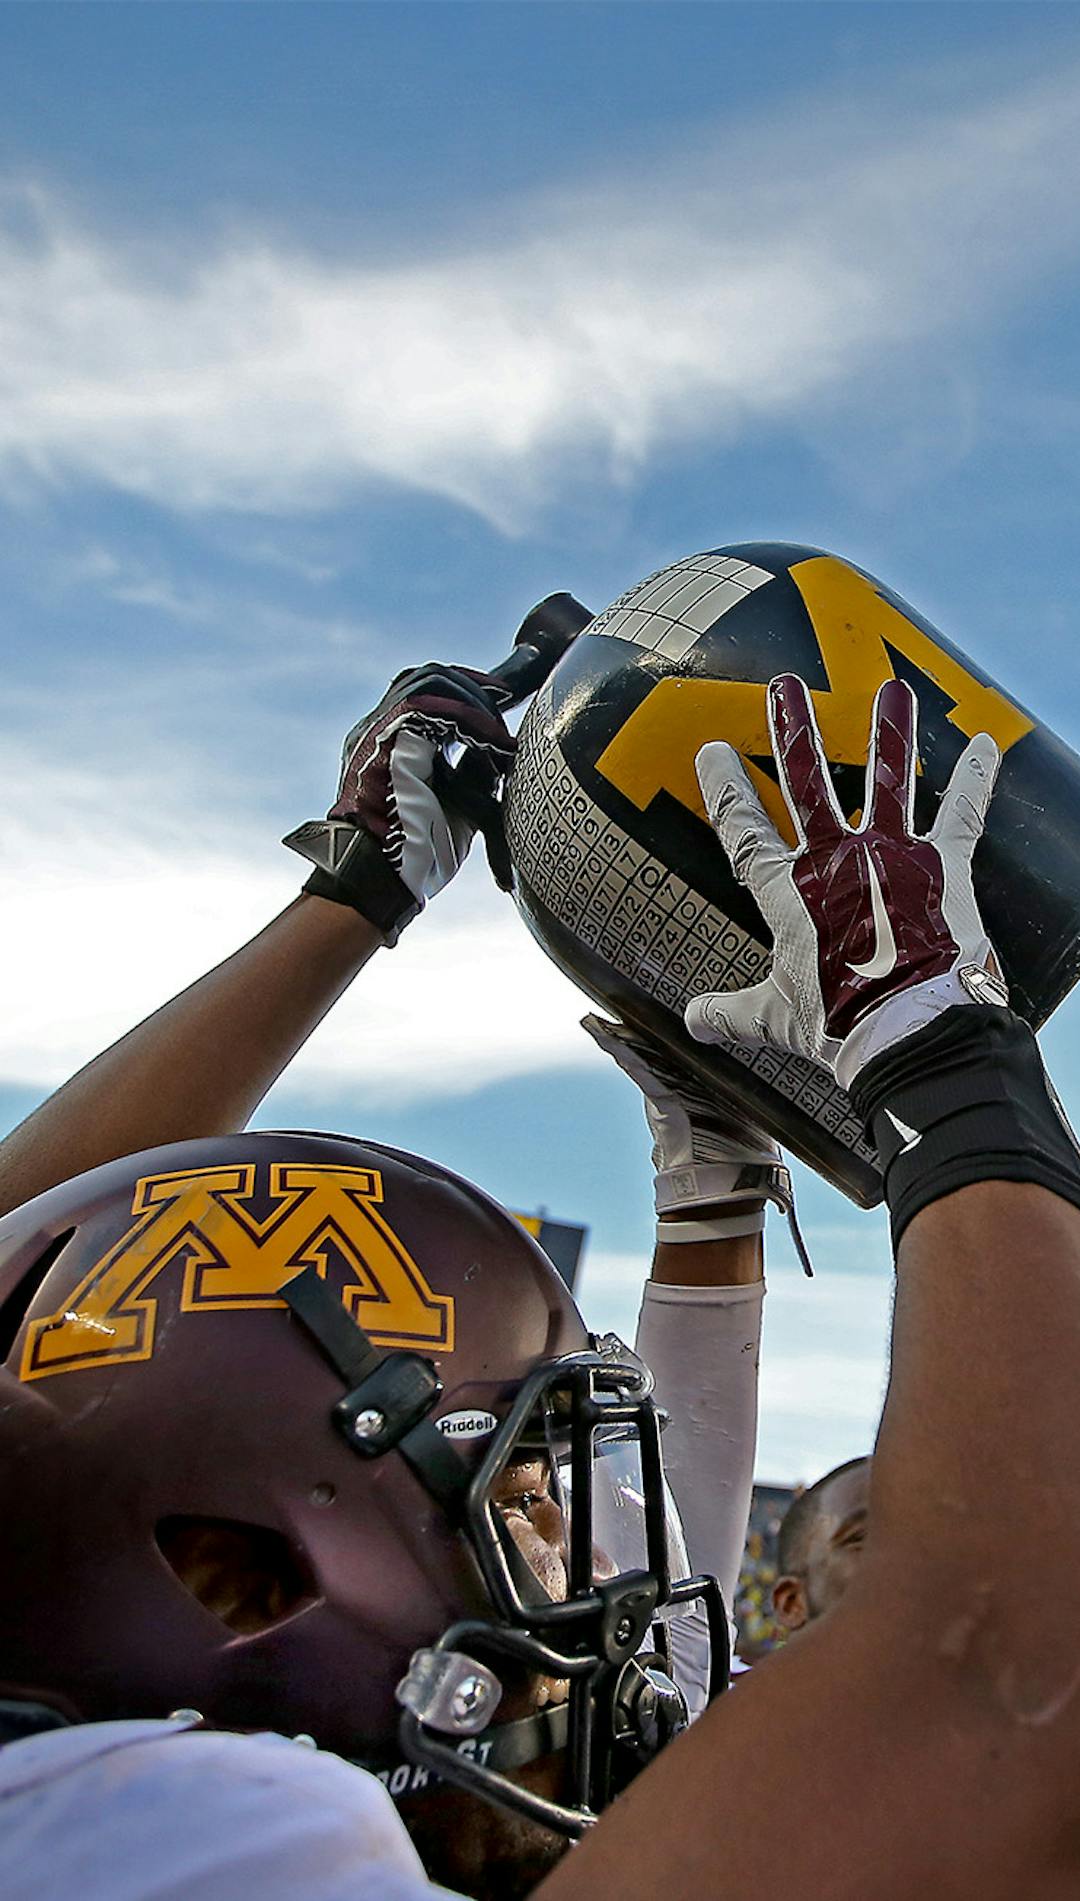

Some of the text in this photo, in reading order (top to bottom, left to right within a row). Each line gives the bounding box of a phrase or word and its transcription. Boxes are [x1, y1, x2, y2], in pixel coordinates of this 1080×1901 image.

[545, 759, 557, 780] 0
[527, 804, 553, 854] 1967
[552, 776, 572, 803] 20
[541, 826, 567, 876] 1968
[564, 796, 588, 827] 20
[547, 818, 599, 913] 35 1969 9
[561, 834, 620, 927] 39 1970 13
[580, 851, 637, 944] 35 1971 7
[600, 866, 660, 959] 42 1972 0
[618, 884, 677, 975] 34 1973 7
[636, 902, 697, 988] 49 1974 0
[656, 914, 723, 1004] 28 1975 21
[691, 958, 723, 994] 1976
[722, 932, 739, 951] 0
[736, 950, 760, 971] 16
[758, 1058, 777, 1078] 37
[801, 1092, 820, 1112] 52
[823, 1110, 840, 1128] 58
[840, 1125, 856, 1143] 31
[19, 1163, 455, 1382] M
[441, 1416, 493, 1434] Riddell
